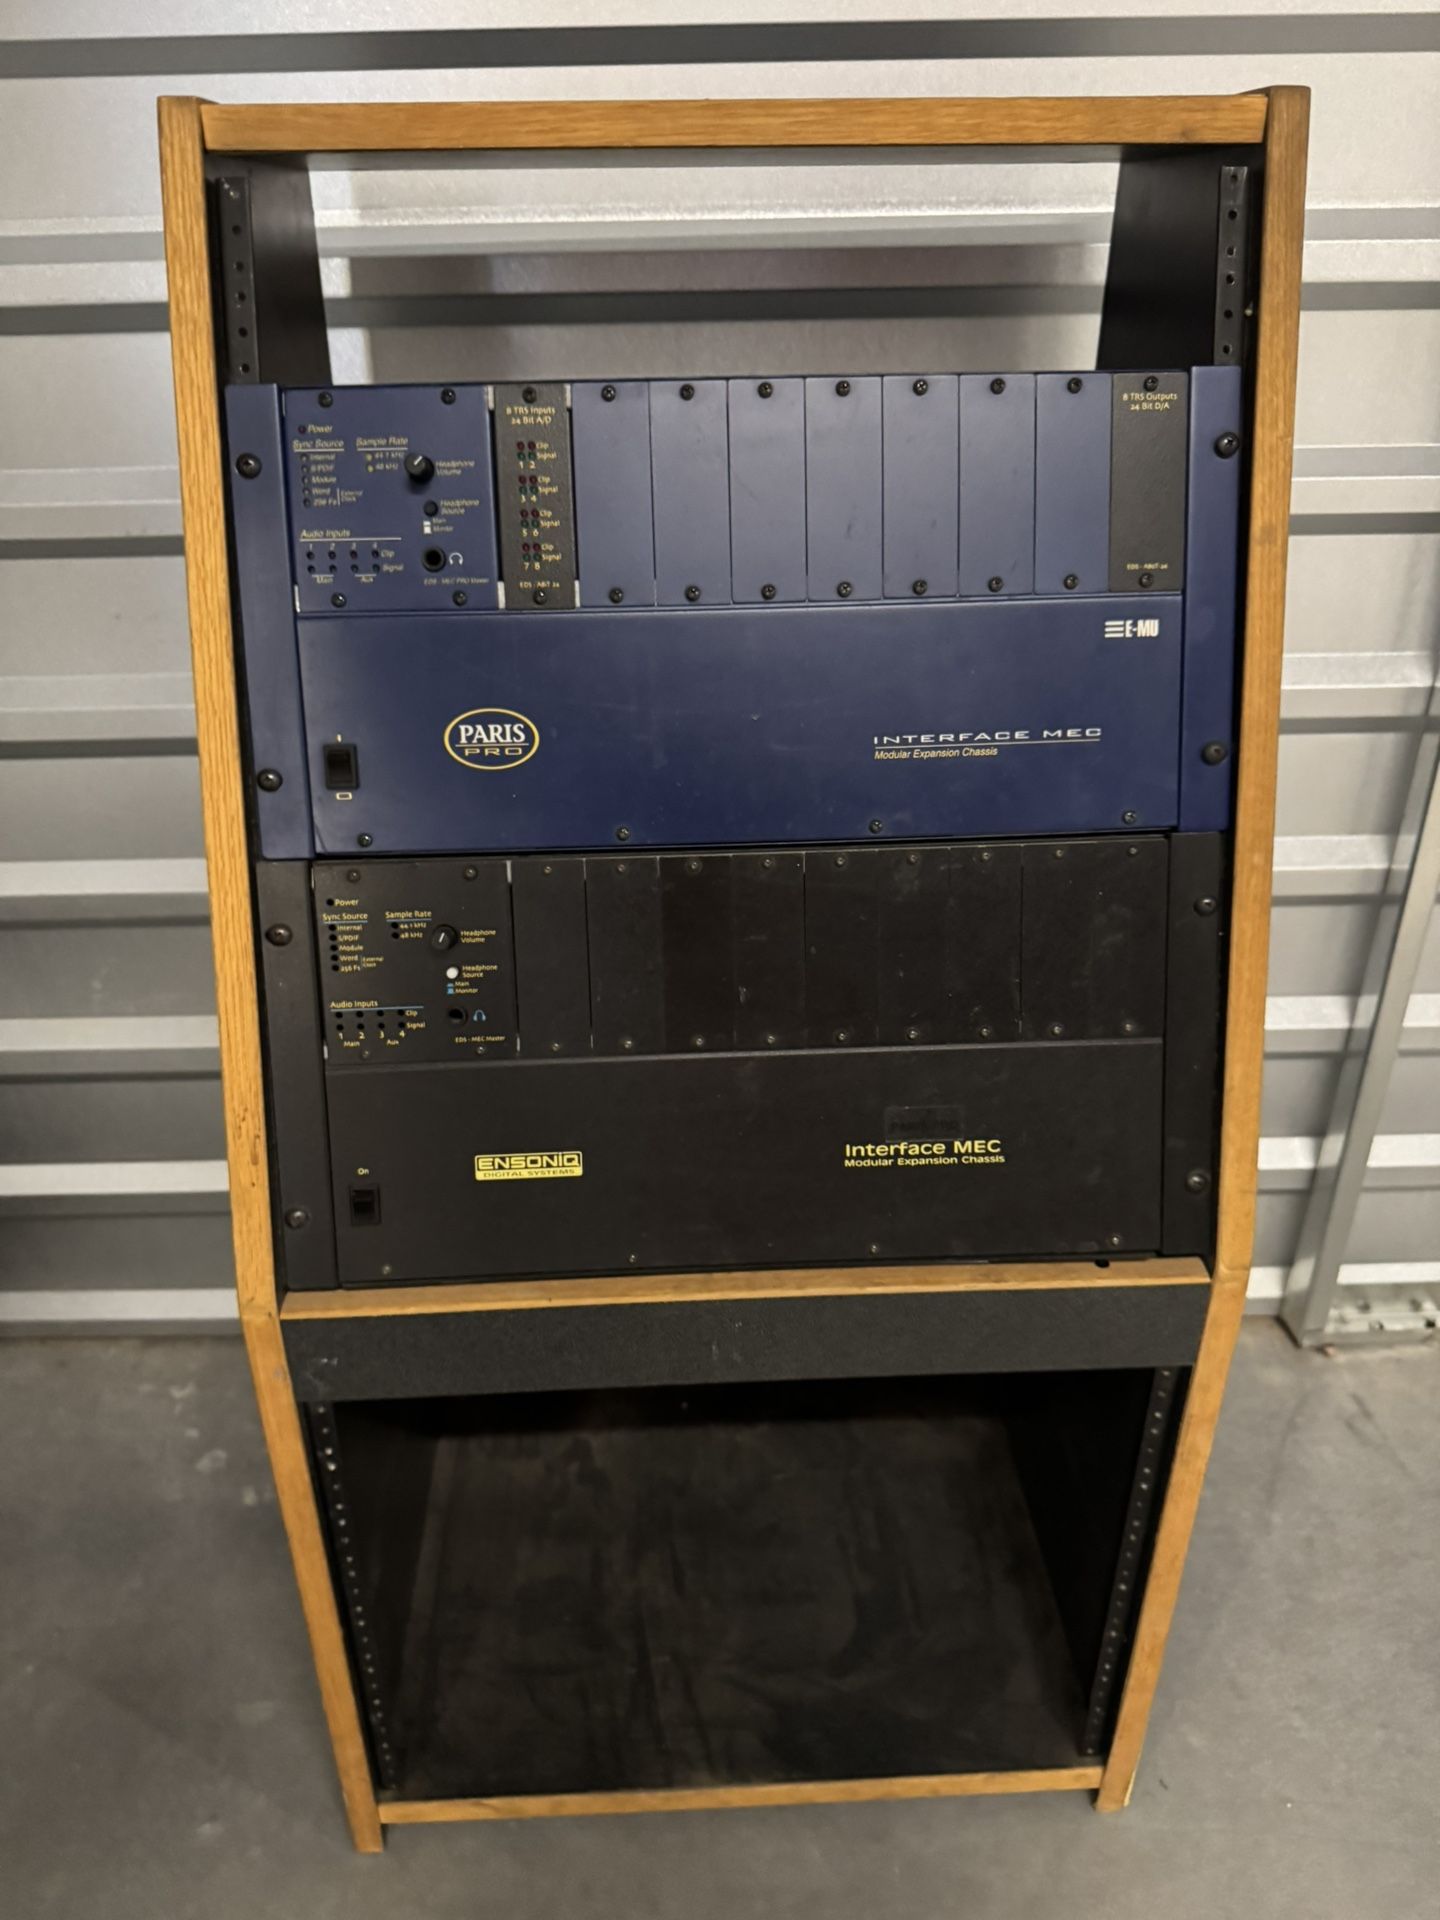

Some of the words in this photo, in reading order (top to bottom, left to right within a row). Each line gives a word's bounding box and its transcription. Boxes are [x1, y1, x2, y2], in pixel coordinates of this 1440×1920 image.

[1123, 393, 1128, 401] 8
[1130, 393, 1144, 401] TRS
[1146, 392, 1177, 401] Outputs
[506, 407, 511, 415] 8
[514, 406, 528, 414] TRS
[530, 406, 555, 416] Inputs
[1142, 402, 1152, 410] Bit
[1155, 402, 1169, 411] D/A
[523, 416, 534, 424] Bit
[536, 416, 552, 425] A/D
[307, 424, 332, 433] Power
[315, 439, 344, 448] Source
[356, 437, 387, 447] Sample
[537, 452, 557, 461] Signal
[529, 461, 536, 469] 2
[540, 510, 552, 518] Clip
[540, 520, 560, 528] Signal
[301, 530, 324, 539] Audio
[326, 529, 350, 539] Inputs
[522, 529, 528, 537] 5
[532, 529, 539, 537] 6
[541, 552, 562, 562] Signal
[524, 562, 529, 571] 7
[534, 562, 540, 570] 8
[1125, 619, 1159, 637] E-MU
[459, 724, 526, 744] PARIS
[874, 731, 1030, 745] INTERFACE
[1042, 728, 1102, 738] MEC
[465, 747, 523, 756] PRO
[874, 750, 911, 760] Modular
[913, 749, 960, 759] Expansion
[962, 747, 998, 757] Chassis
[322, 913, 341, 922] Sync
[342, 912, 368, 920] Source
[385, 911, 413, 919] Sample
[330, 1001, 353, 1009] Audio
[354, 1000, 378, 1009] Inputs
[405, 1009, 418, 1017] Clip
[406, 1022, 426, 1031] Signal
[359, 1031, 365, 1039] 2
[380, 1030, 385, 1039] 3
[399, 1030, 405, 1038] 4
[845, 1142, 946, 1157] Interface
[953, 1139, 1001, 1153] MEC
[478, 1154, 579, 1170] ENSONIQ
[844, 1158, 894, 1167] Modular
[897, 1156, 958, 1167] Expansion
[961, 1154, 1006, 1164] Chassis
[357, 1167, 369, 1175] On
